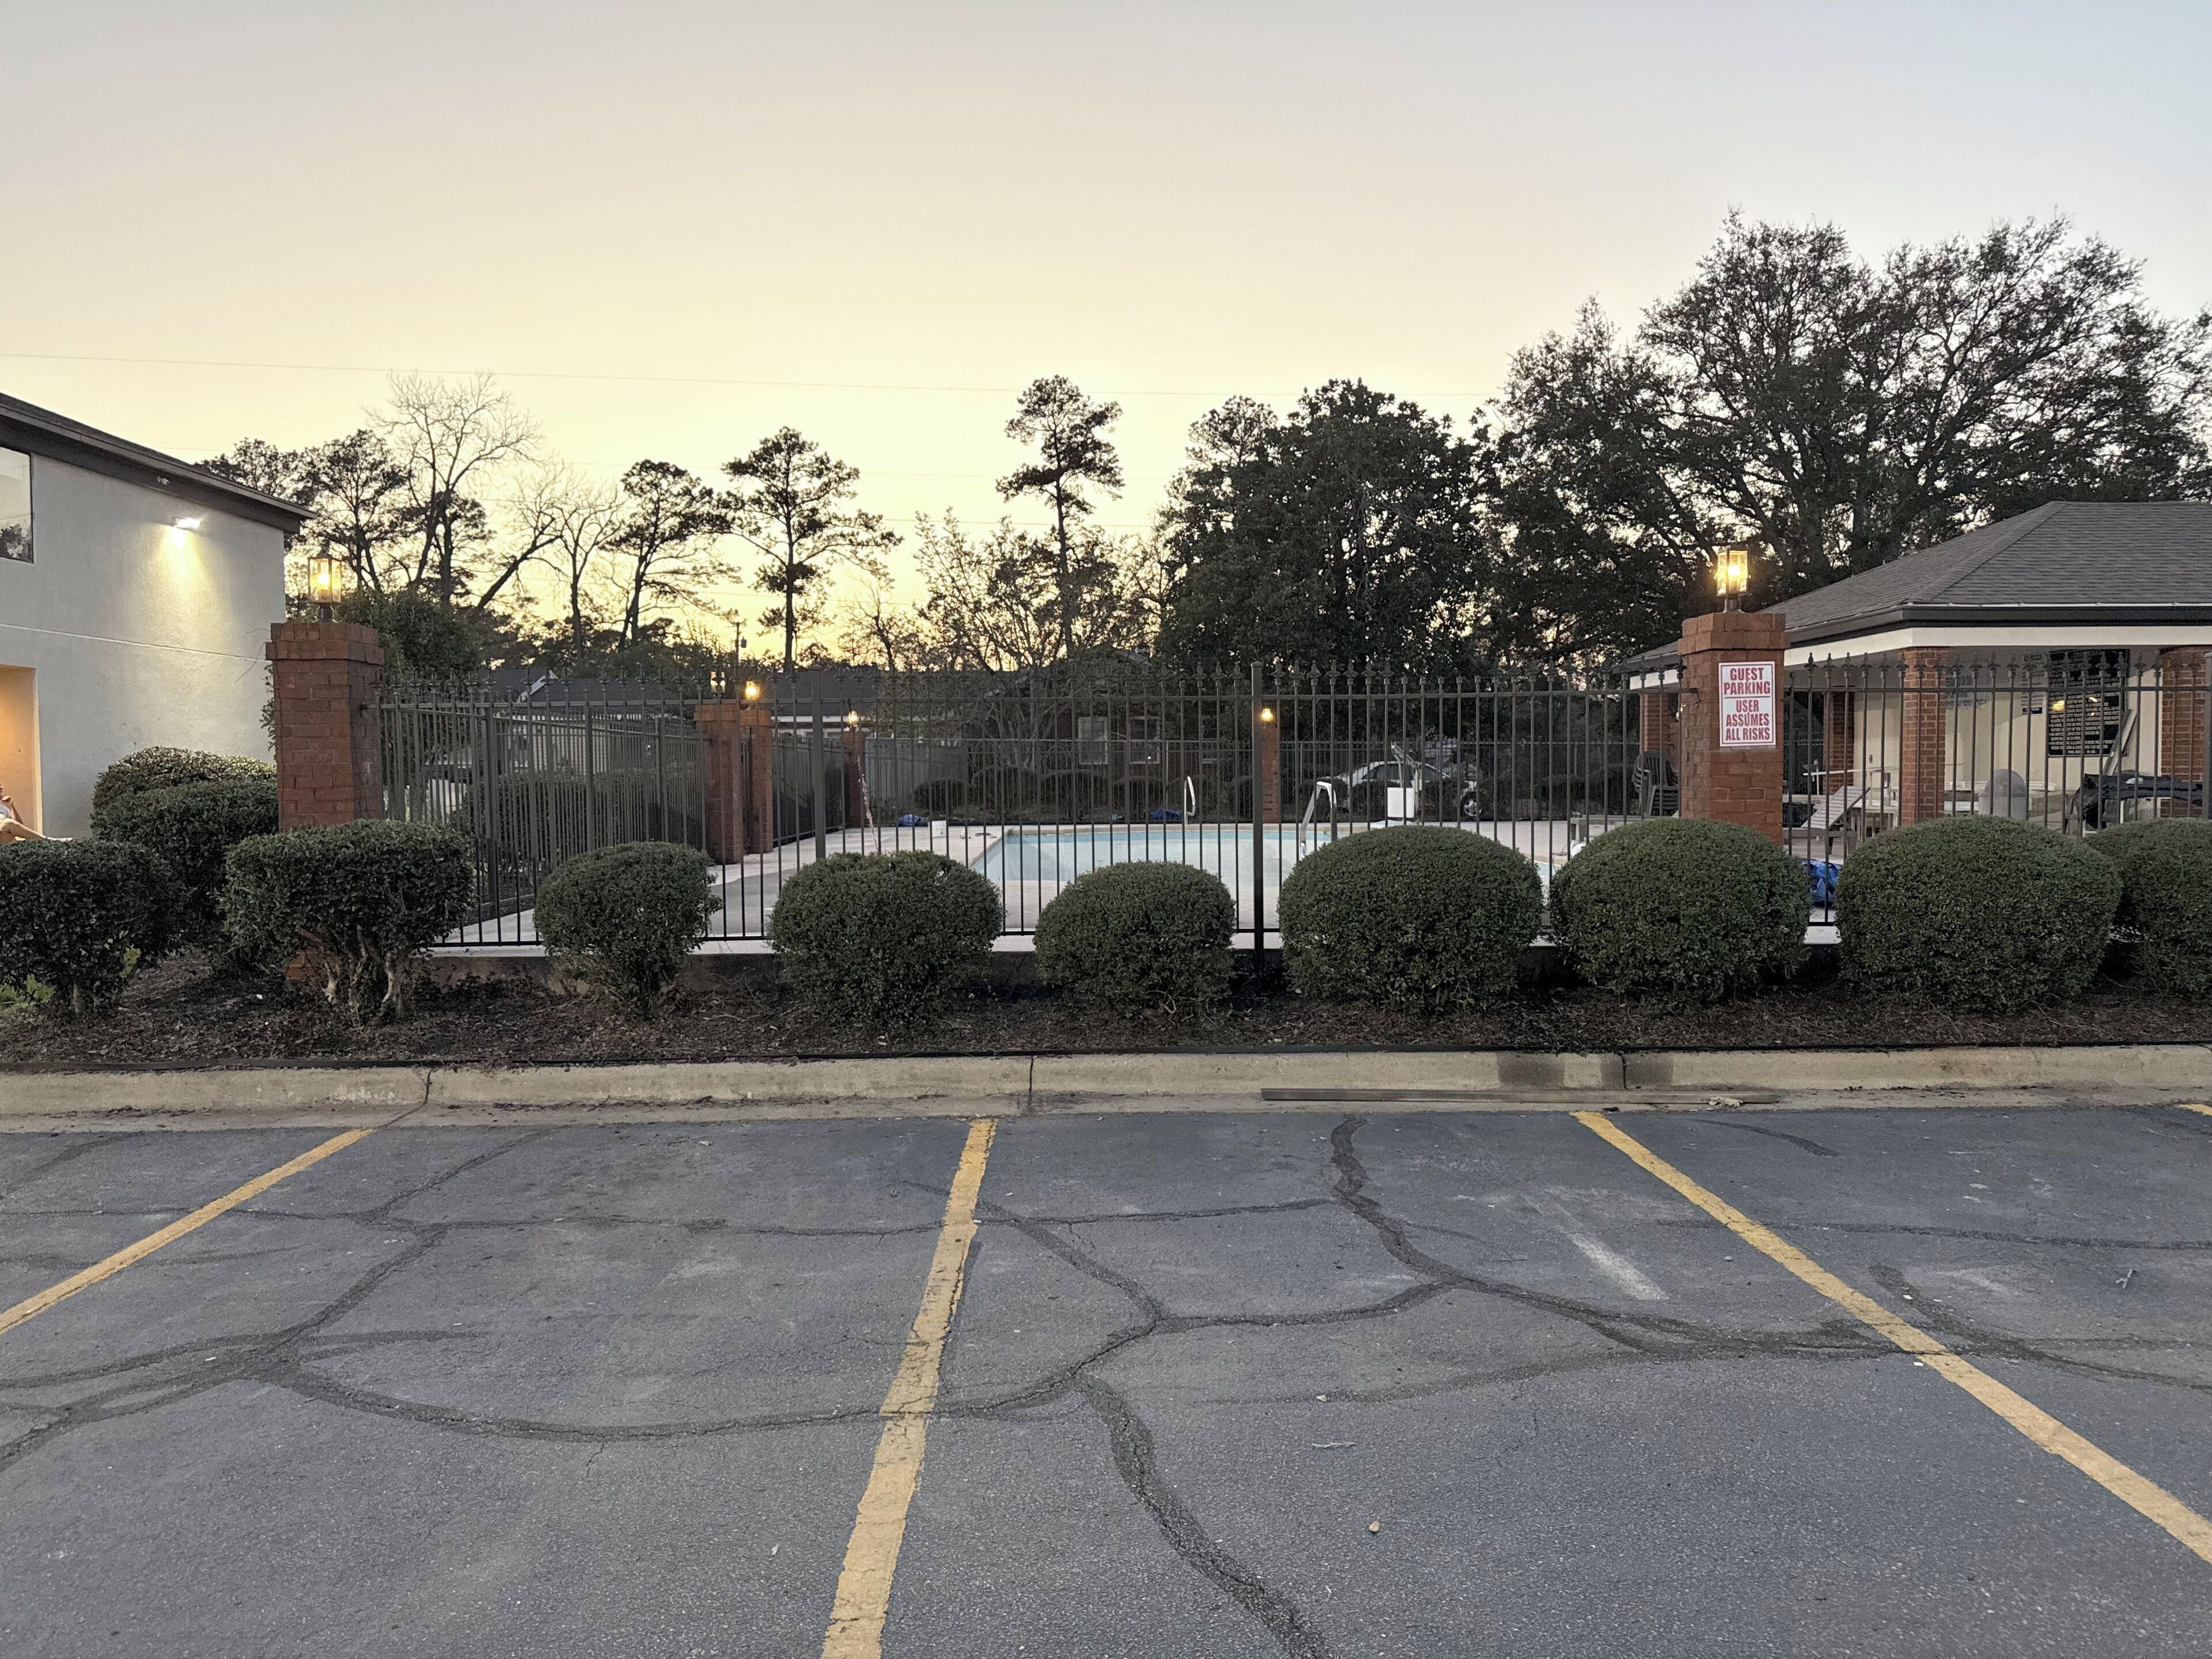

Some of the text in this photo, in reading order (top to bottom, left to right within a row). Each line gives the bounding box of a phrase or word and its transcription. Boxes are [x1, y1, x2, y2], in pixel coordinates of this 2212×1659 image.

[1730, 668, 1764, 681] GUEST
[1724, 681, 1770, 695] PARKING
[1736, 700, 1759, 713] USER
[1726, 714, 1769, 726] ASSUMES
[1726, 728, 1770, 741] ALL RISKS
